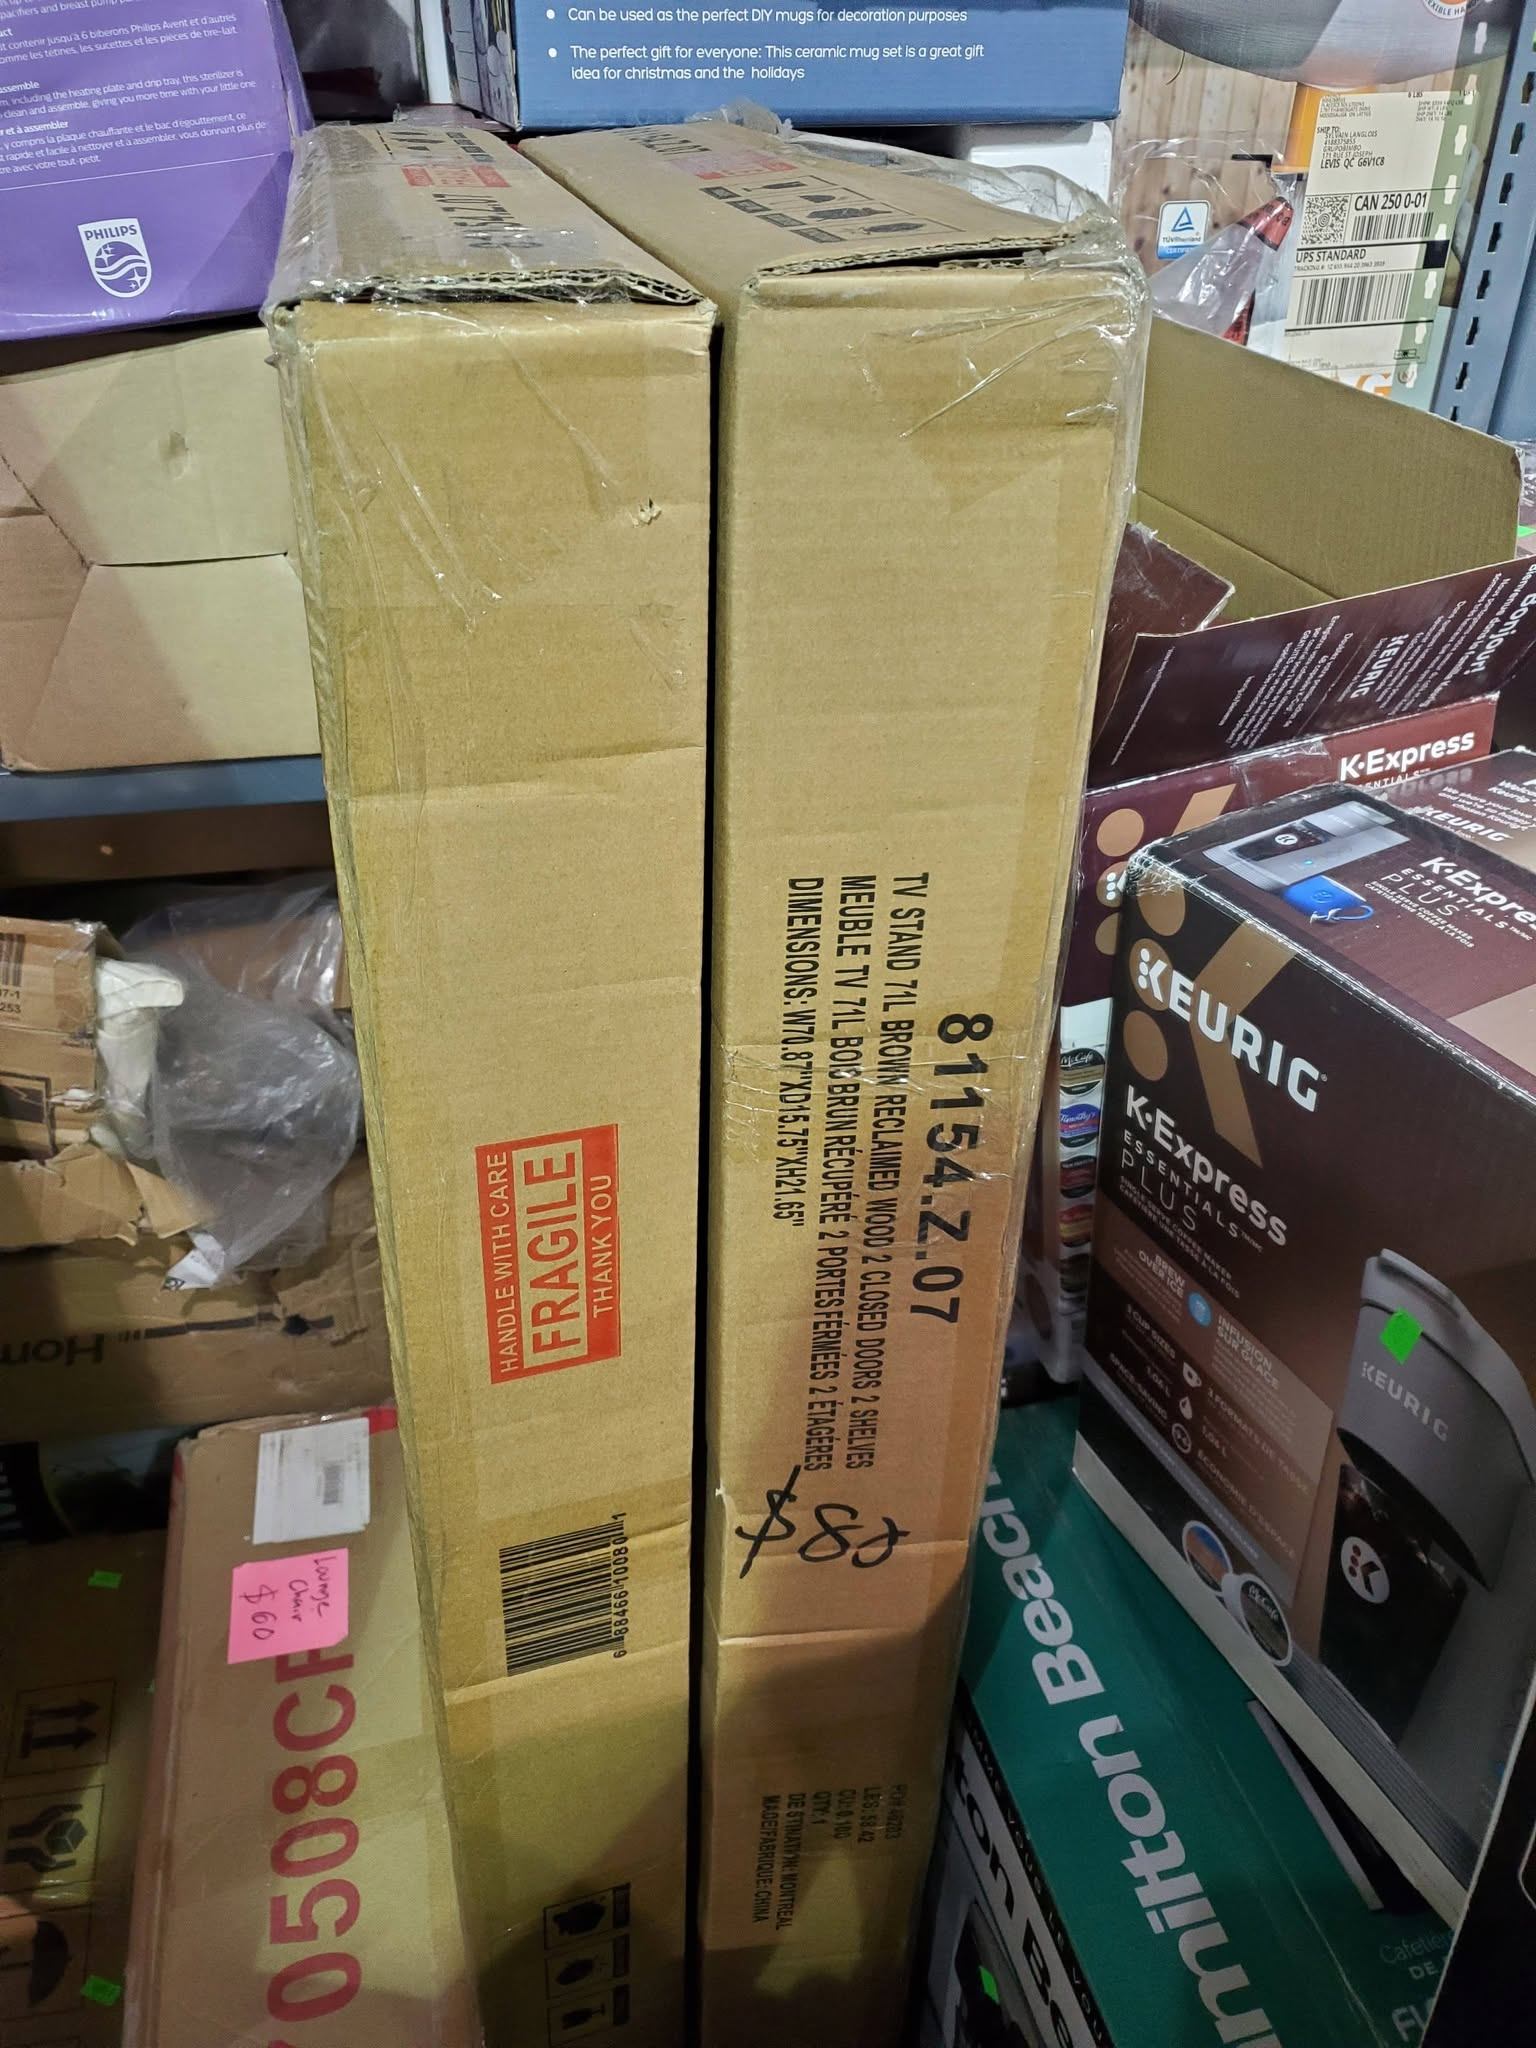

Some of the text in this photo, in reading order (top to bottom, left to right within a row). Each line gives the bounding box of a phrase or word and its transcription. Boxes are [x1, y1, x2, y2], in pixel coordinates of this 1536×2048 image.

[40, 3, 58, 14] and
[568, 8, 968, 24] Can be used as the perfect DIY mugs for decoration purposes
[8, 19, 189, 51] contenir biberons Philips Avent
[95, 30, 202, 51] sucettes de
[570, 44, 984, 62] The perfect gift for everyone: This ceramic mug set is a great gift
[53, 90, 68, 100] the
[69, 87, 102, 99] heating
[102, 82, 125, 95] plate
[126, 80, 143, 91] and
[571, 66, 805, 82] idea for christmas and the holidays
[29, 84, 218, 115] and more time with your
[5, 122, 255, 162] rapide nettoyer vous donnant plus
[11, 126, 133, 150] compris plaque chauffante
[24, 120, 69, 135] assembler
[12, 160, 57, 173] avec votre
[1320, 157, 1385, 169] LEVIS QC G6V1C8
[1354, 191, 1428, 211] CAN 250 0-01
[84, 224, 137, 241] PHILIPS
[1296, 248, 1366, 264] UPS STANDARD
[1350, 633, 1409, 699] KEURIG
[1424, 805, 1514, 841] KEURIG
[1381, 873, 1460, 916] PLUS
[1401, 868, 1509, 929] ESSENTIALS
[836, 875, 877, 957] MEUBLE
[783, 876, 824, 1006] DIMENSIONS:
[833, 965, 870, 989] TV
[831, 997, 867, 1030] 71L
[1137, 948, 1321, 1113] KEURIG
[827, 1036, 864, 1080] BOIS
[825, 1082, 860, 1131] BRUN
[819, 1134, 863, 1224] RÉCUPÉRÉ
[845, 872, 930, 1470] TV STAND 71L BROWN RECLAIMED WOOD 2 CLOSED DOORS 2 SHELVES
[1121, 1148, 1198, 1231] PLUS
[1123, 1129, 1239, 1239] ESSENTIALS
[524, 1152, 581, 1354] FRAGILE
[590, 1174, 614, 1319] THANK YOU
[817, 1230, 850, 1240] 2
[487, 1151, 519, 1373] HANDLE WITH CARE
[814, 1246, 848, 1309] PORTES
[1138, 1250, 1165, 1281] OVER
[1166, 1274, 1185, 1300] ICE
[1155, 1253, 1186, 1289] BREW
[1218, 1314, 1273, 1372] INFUSION
[808, 1386, 838, 1395] 2
[1361, 1359, 1450, 1440] KEURIG
[611, 1512, 629, 1659] 6 88466 10080 1
[751, 1890, 772, 1924] CHINA
[775, 1873, 801, 1931] MONTREAL
